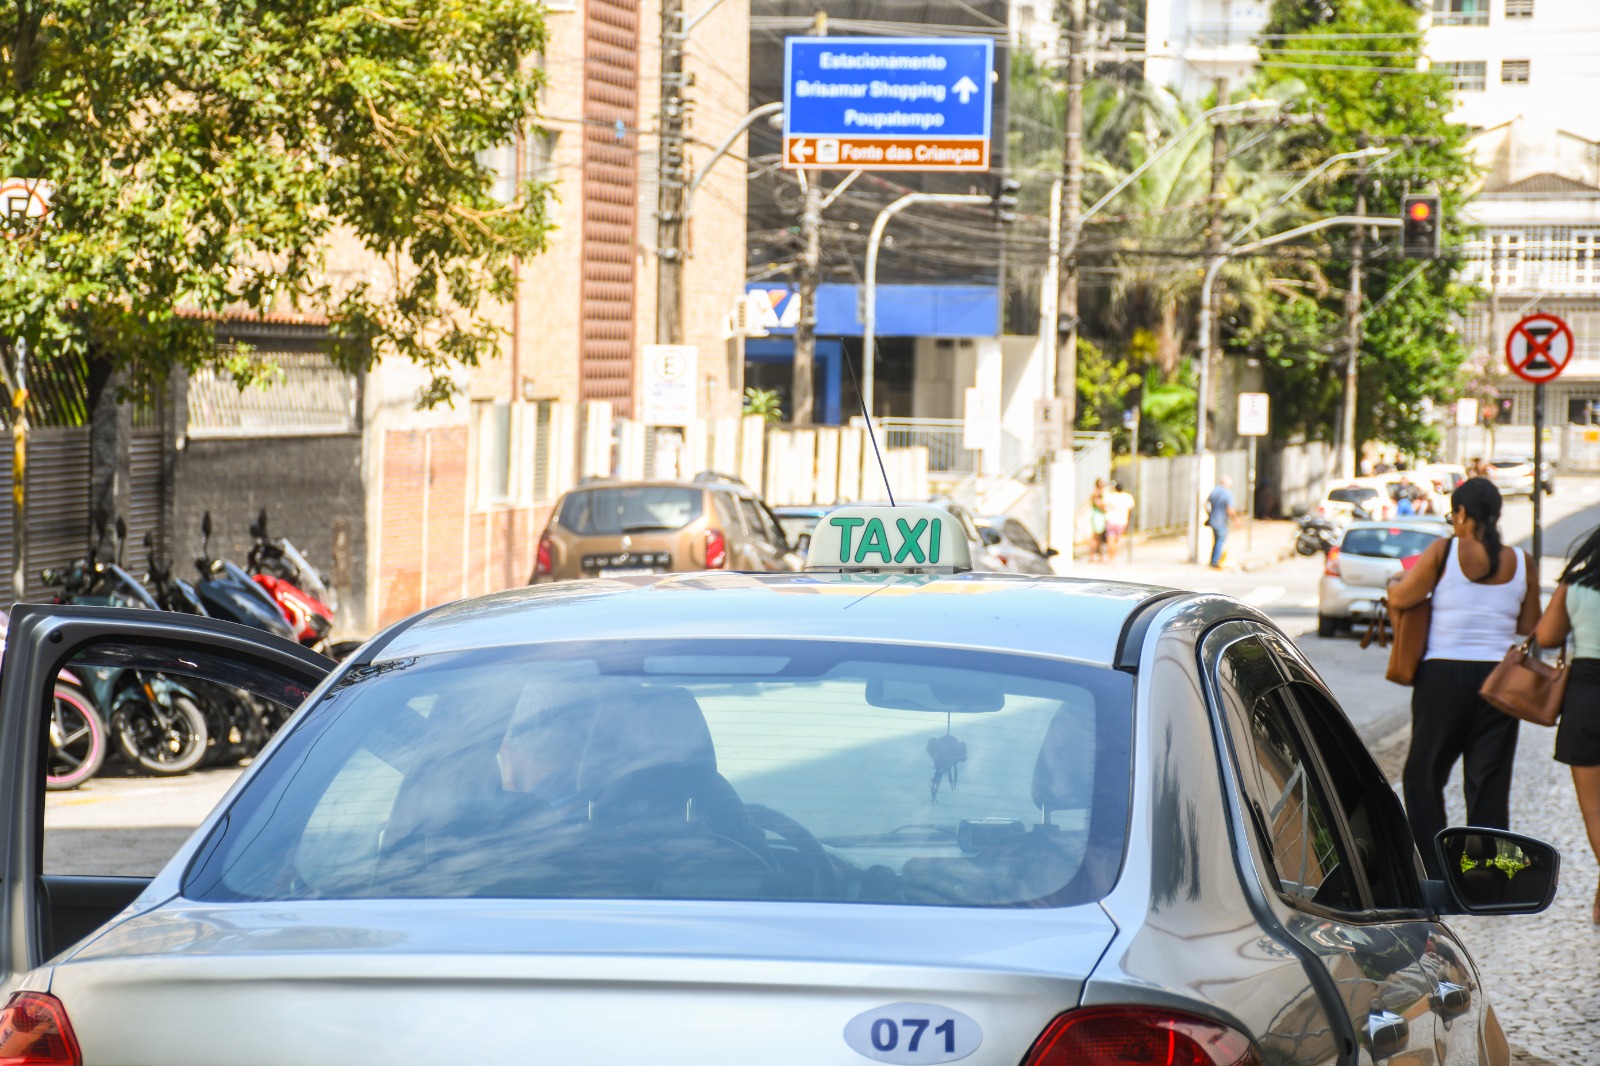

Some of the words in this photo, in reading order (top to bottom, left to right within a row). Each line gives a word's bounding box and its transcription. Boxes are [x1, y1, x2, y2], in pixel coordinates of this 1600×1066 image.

[819, 51, 947, 71] Estacionamento
[795, 80, 868, 98] Brisamar
[869, 80, 947, 102] Shopping
[843, 109, 945, 130] Poupatempo
[841, 143, 884, 161] Fonte
[885, 144, 913, 161] das
[915, 144, 980, 165] Crianças
[830, 517, 942, 564] TAXI
[870, 1018, 955, 1053] 071
